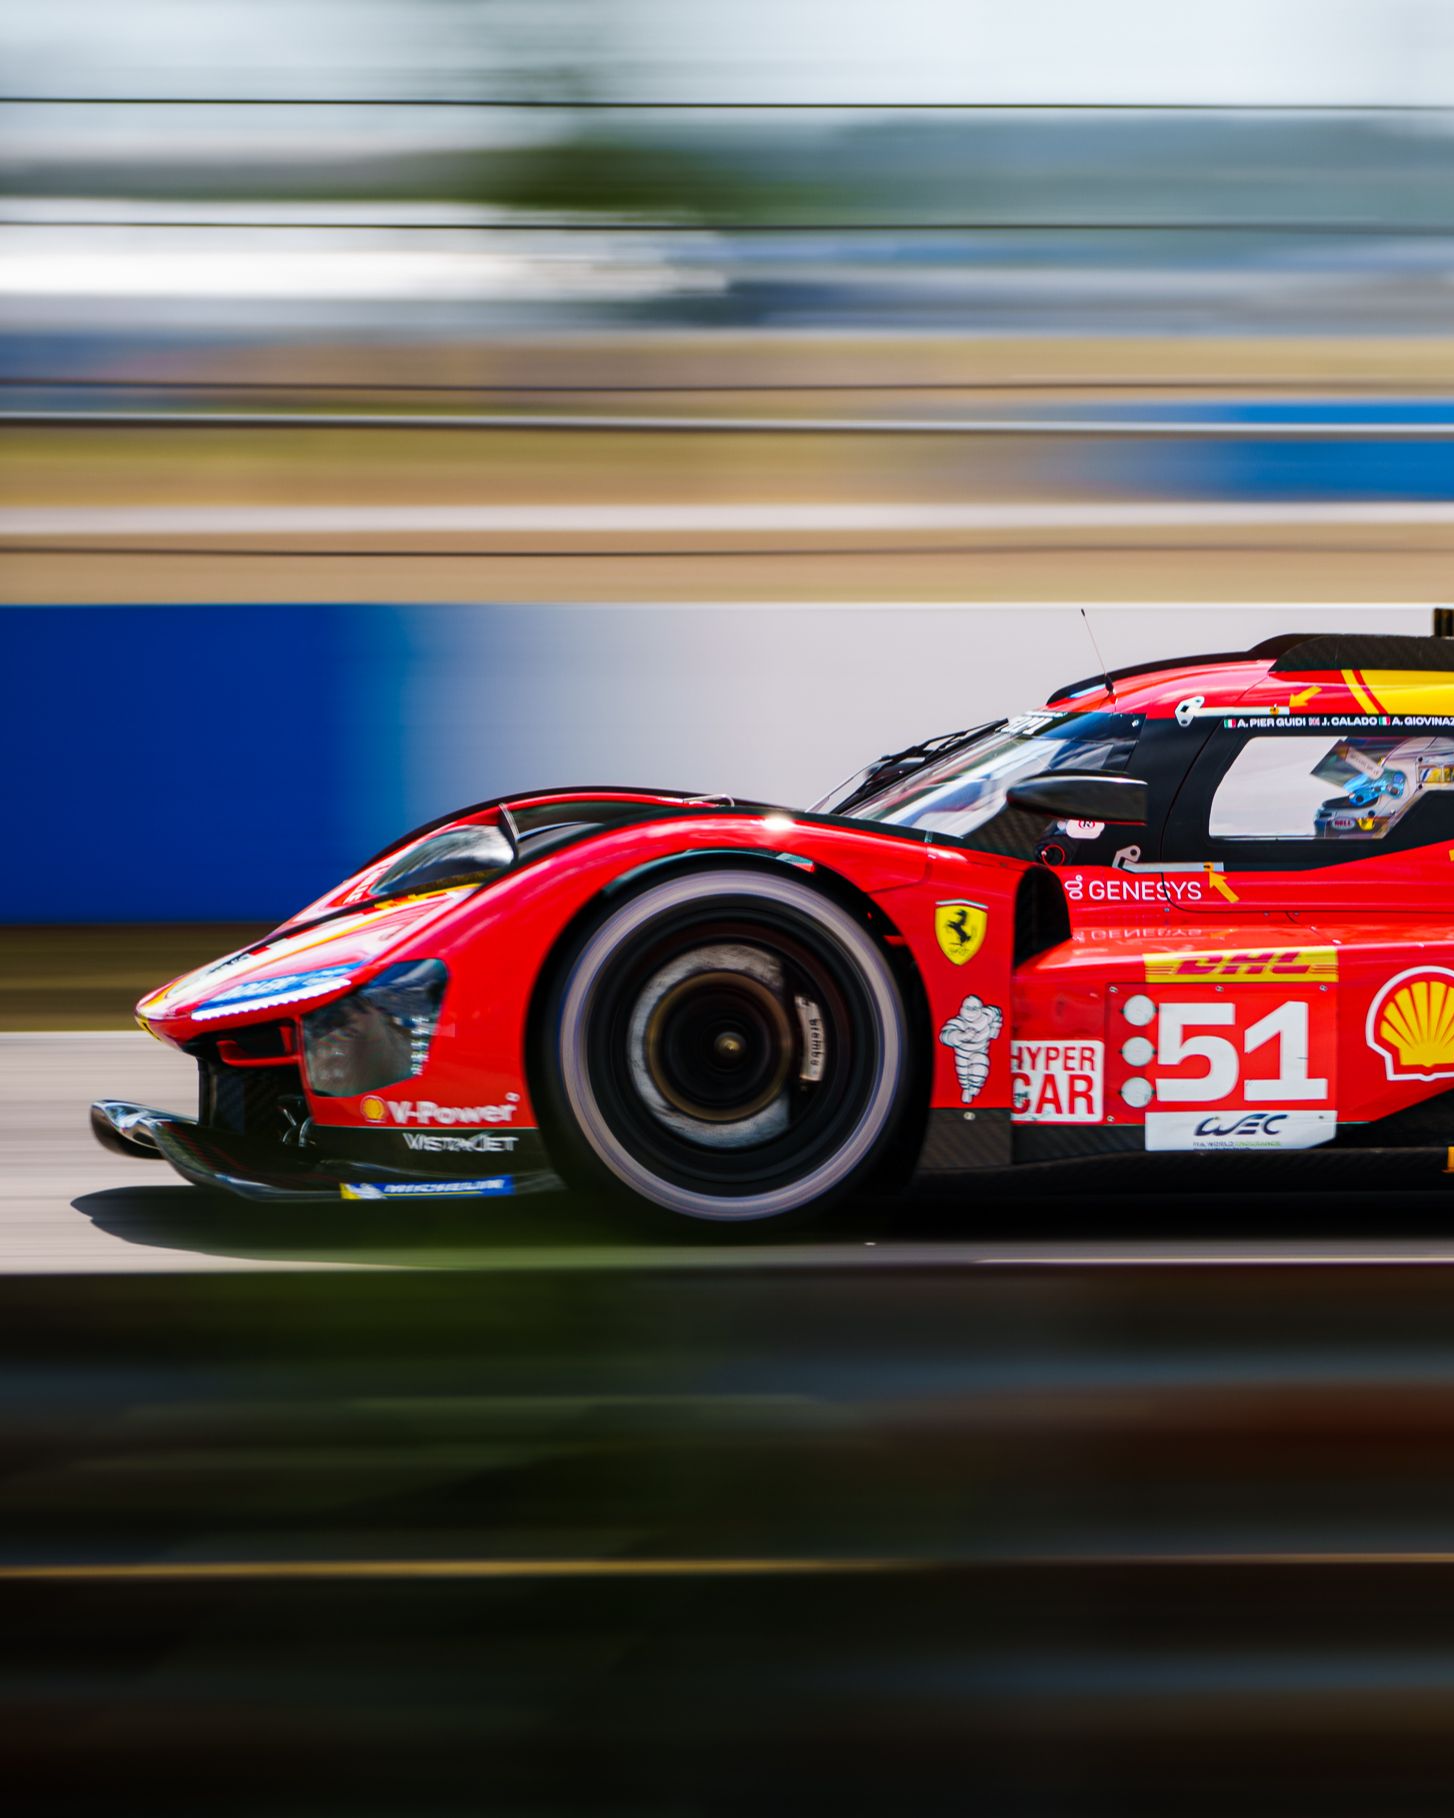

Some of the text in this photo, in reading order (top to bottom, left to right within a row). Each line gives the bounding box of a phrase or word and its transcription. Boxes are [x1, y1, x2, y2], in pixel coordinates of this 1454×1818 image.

[1236, 718, 1249, 729] A.
[1250, 717, 1275, 728] PIER
[1276, 717, 1307, 728] GUIDI
[1321, 717, 1331, 727] J.
[1331, 716, 1377, 727] CALADO
[1392, 716, 1404, 727] A.
[1089, 880, 1202, 900] GENESYS
[1174, 951, 1312, 976] DHL
[1011, 1046, 1096, 1072] HYPER
[1155, 1000, 1329, 1102] 51
[1011, 1073, 1095, 1115] CAR
[386, 1100, 517, 1125] V-Power
[1193, 1113, 1289, 1137] WEC
[384, 1179, 505, 1193] MICHELIN
